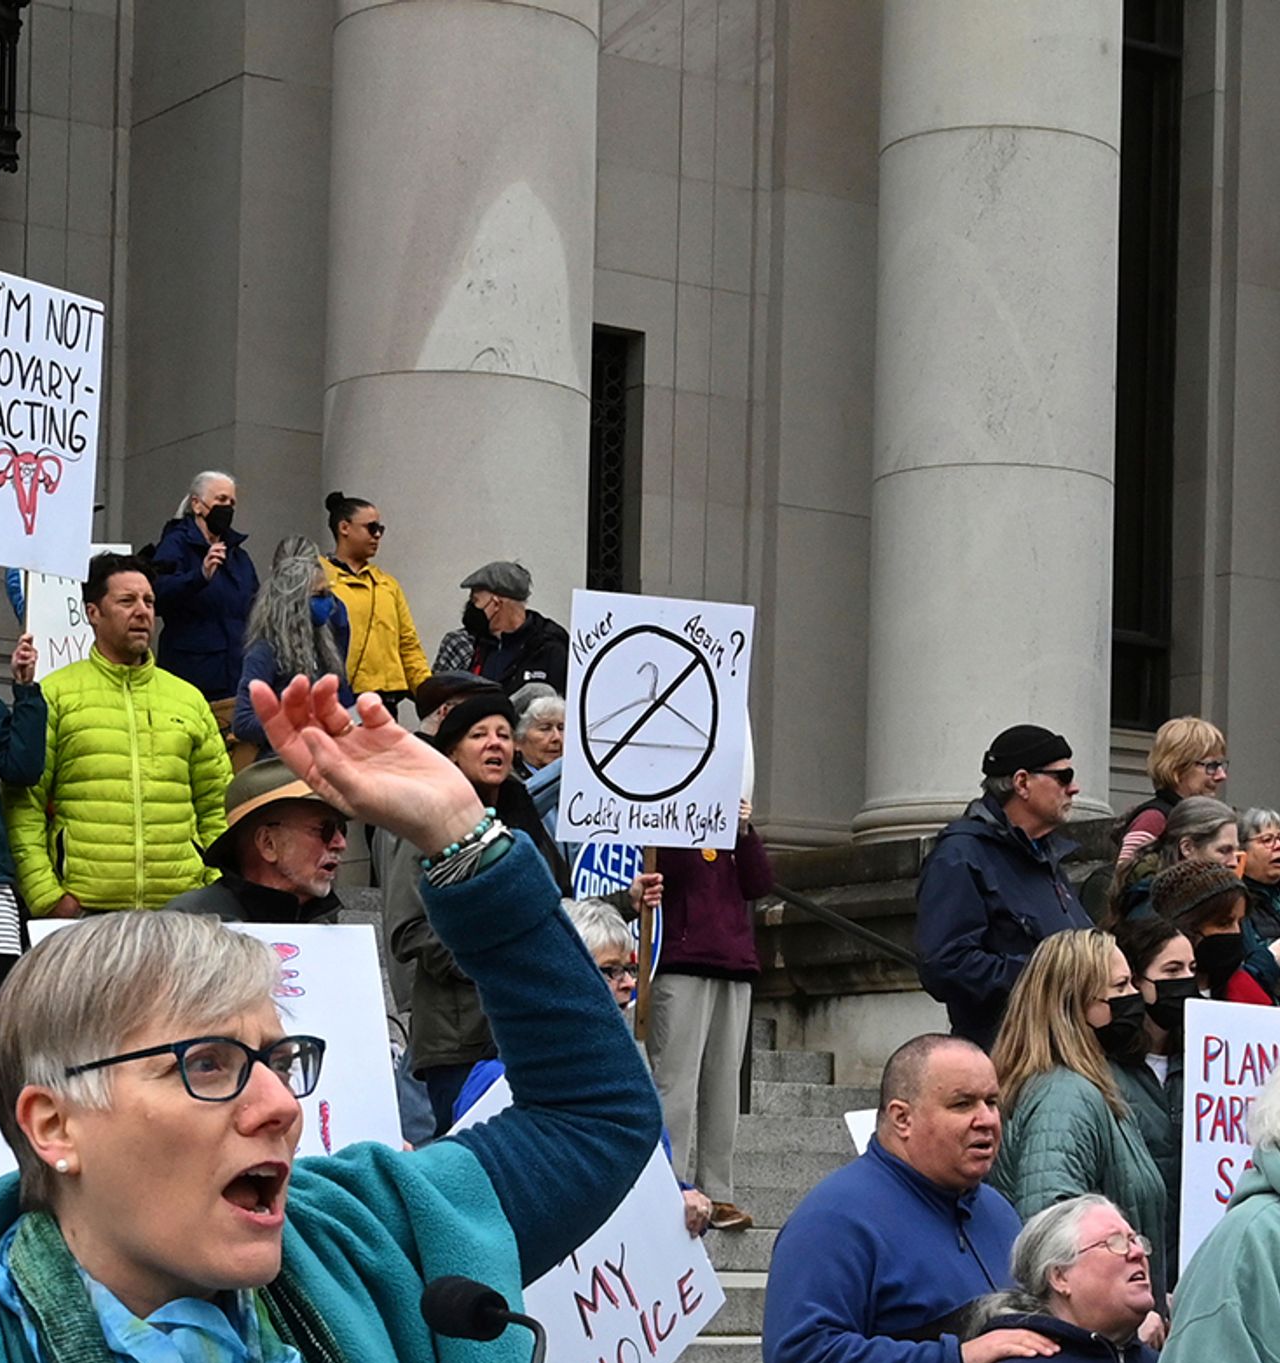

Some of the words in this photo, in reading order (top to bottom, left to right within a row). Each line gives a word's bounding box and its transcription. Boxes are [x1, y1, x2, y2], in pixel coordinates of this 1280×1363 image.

[46, 298, 105, 352] NOT
[572, 611, 614, 666] Never
[568, 791, 622, 836] Codify
[628, 802, 680, 831] Health
[685, 801, 727, 845] Rights
[574, 1242, 640, 1340] MY
